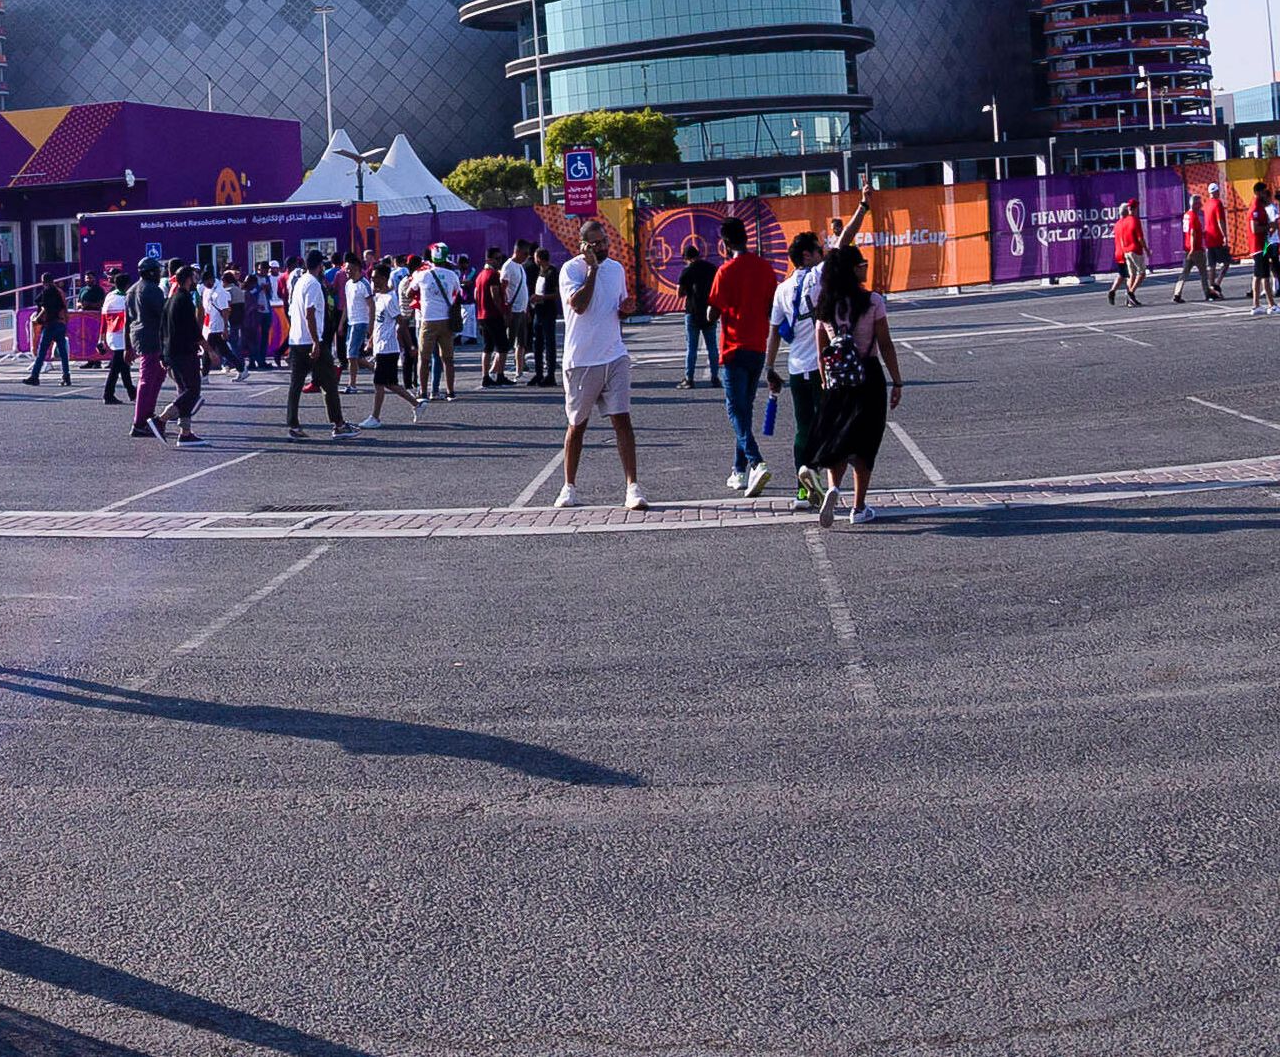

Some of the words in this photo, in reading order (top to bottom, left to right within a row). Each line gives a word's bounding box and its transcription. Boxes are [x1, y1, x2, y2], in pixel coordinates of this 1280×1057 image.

[1031, 211, 1056, 225] FIFA
[1056, 208, 1099, 223] WORLD
[1037, 226, 1082, 246] Qatar
